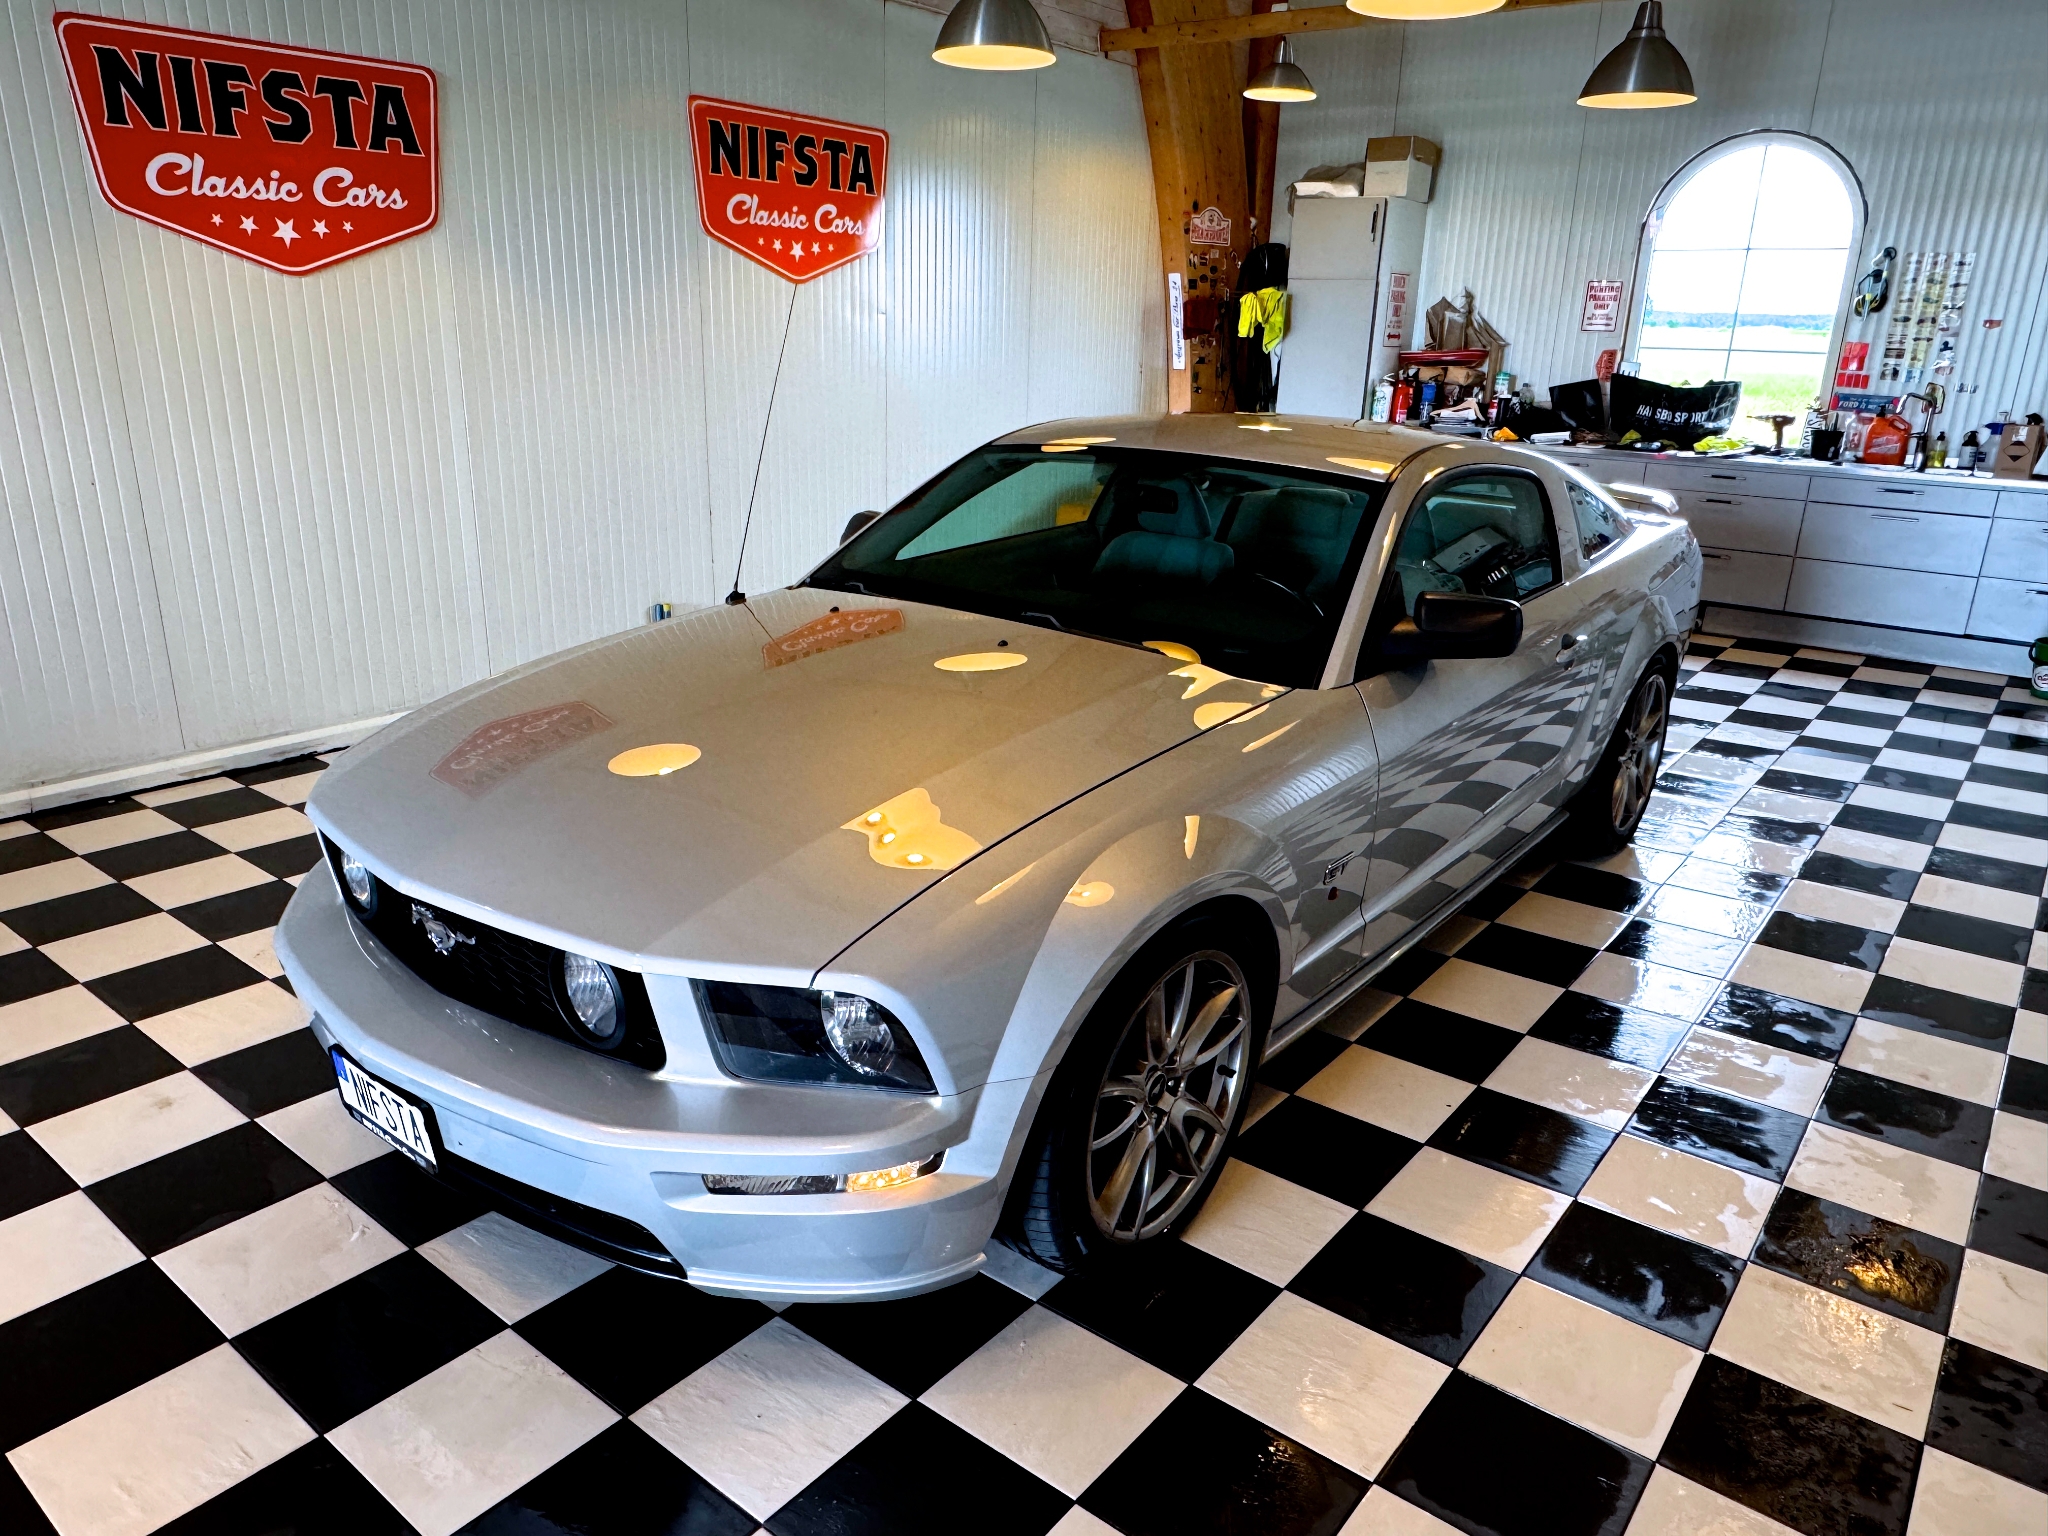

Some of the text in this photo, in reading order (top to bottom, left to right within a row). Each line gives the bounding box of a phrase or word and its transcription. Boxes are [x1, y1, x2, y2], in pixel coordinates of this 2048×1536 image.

[90, 43, 425, 158] NIFSTA
[144, 152, 408, 211] Classic Cars
[706, 117, 877, 197] NIFSTA
[726, 193, 865, 236] Classic Cars
[348, 1067, 428, 1154] NIFSTA
